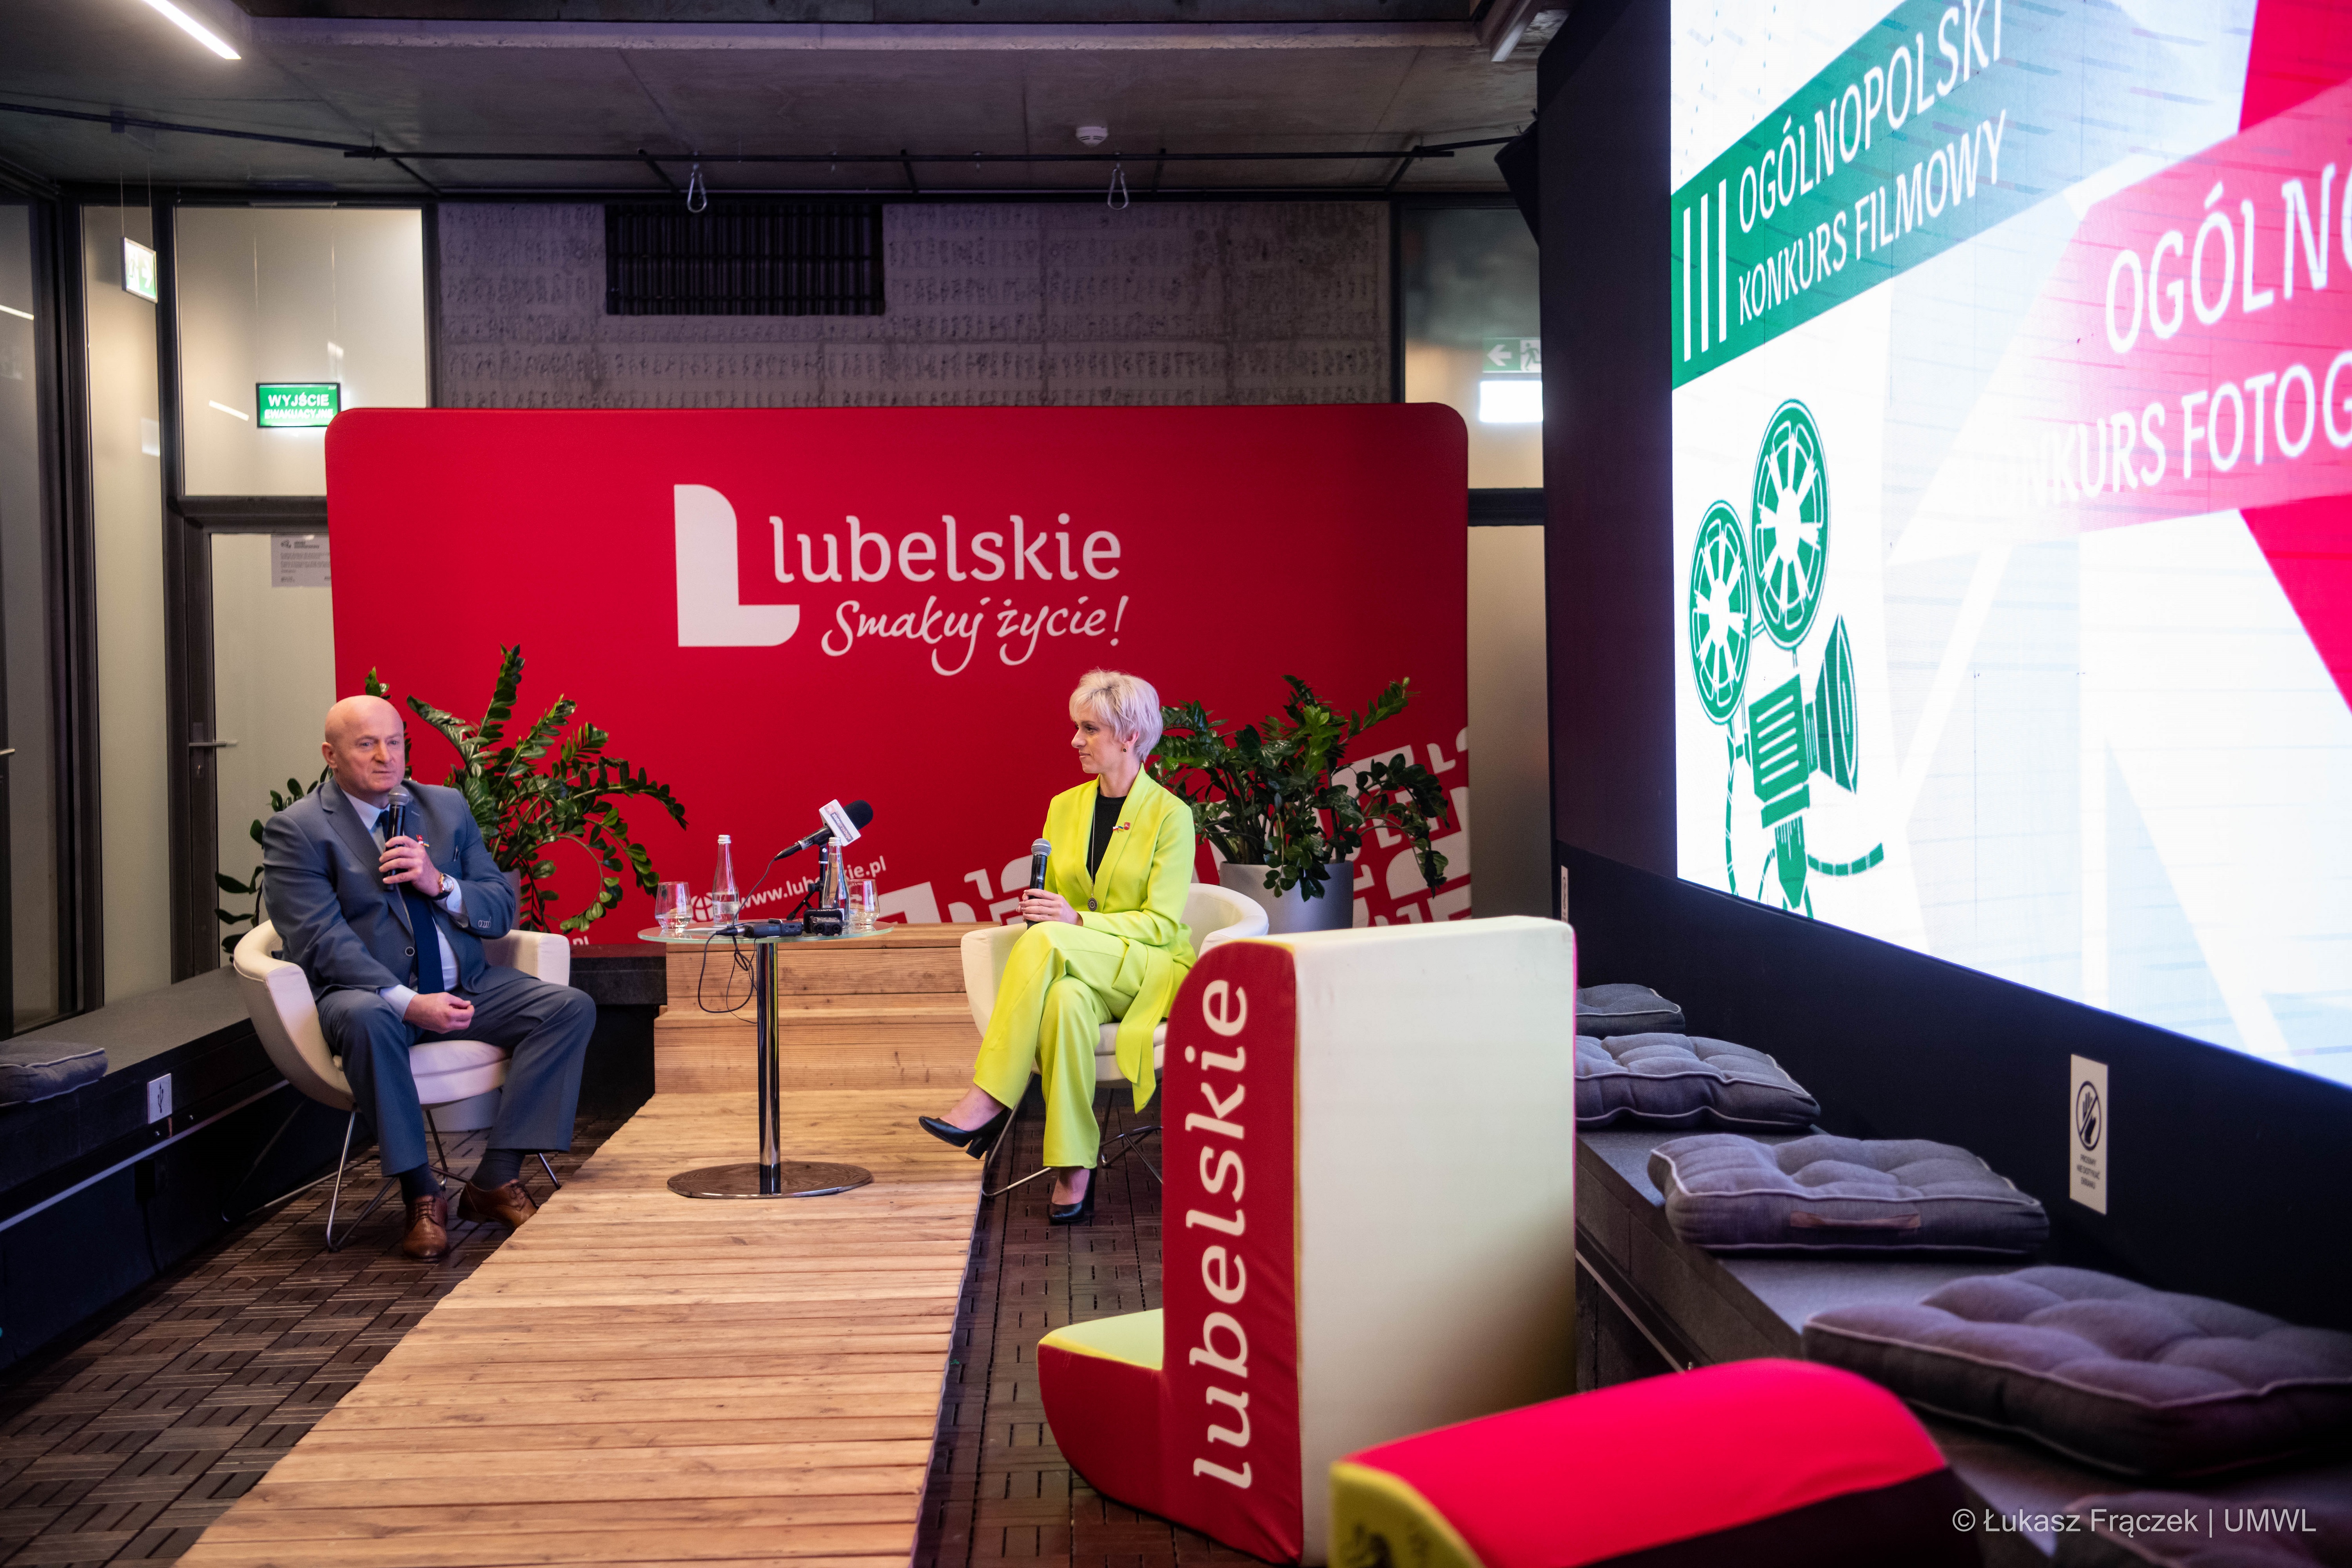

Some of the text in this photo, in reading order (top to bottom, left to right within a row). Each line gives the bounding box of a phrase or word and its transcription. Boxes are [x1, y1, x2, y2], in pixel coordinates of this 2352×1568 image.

[1739, 0, 2002, 233] OGÓLNOPOLSKI
[1684, 179, 1726, 362] III
[1739, 109, 2006, 325] KONKURS FILMOWY
[264, 408, 334, 419] EWAKUACYJNE
[268, 392, 329, 407] WYJŚCIE
[769, 513, 1122, 583] lubelskie
[821, 595, 1129, 676] Smakuj życie!
[1185, 979, 1253, 1489] lubelskie
